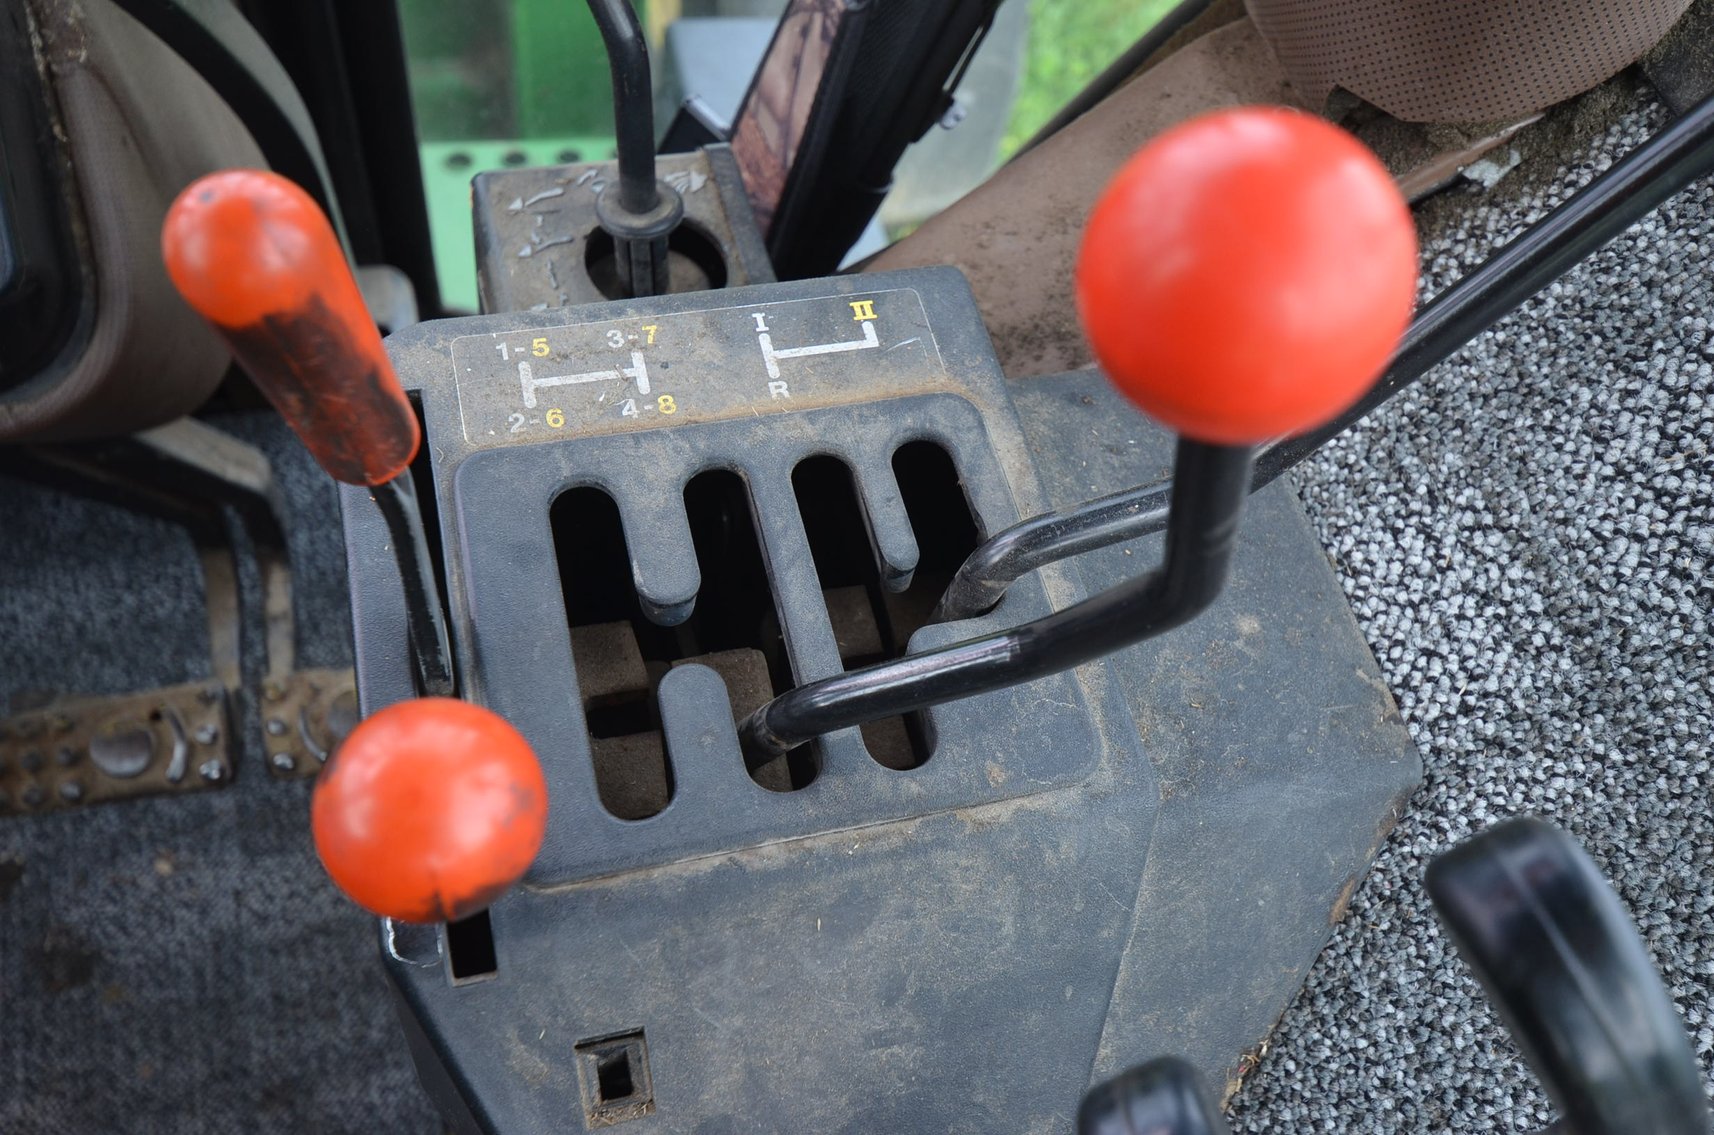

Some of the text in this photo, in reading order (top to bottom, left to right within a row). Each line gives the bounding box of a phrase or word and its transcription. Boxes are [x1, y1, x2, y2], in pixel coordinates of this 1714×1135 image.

[849, 300, 878, 321] II
[496, 338, 550, 361] 1-5
[768, 381, 790, 400] R
[622, 394, 677, 419] 4-8
[508, 408, 565, 433] 2-6
